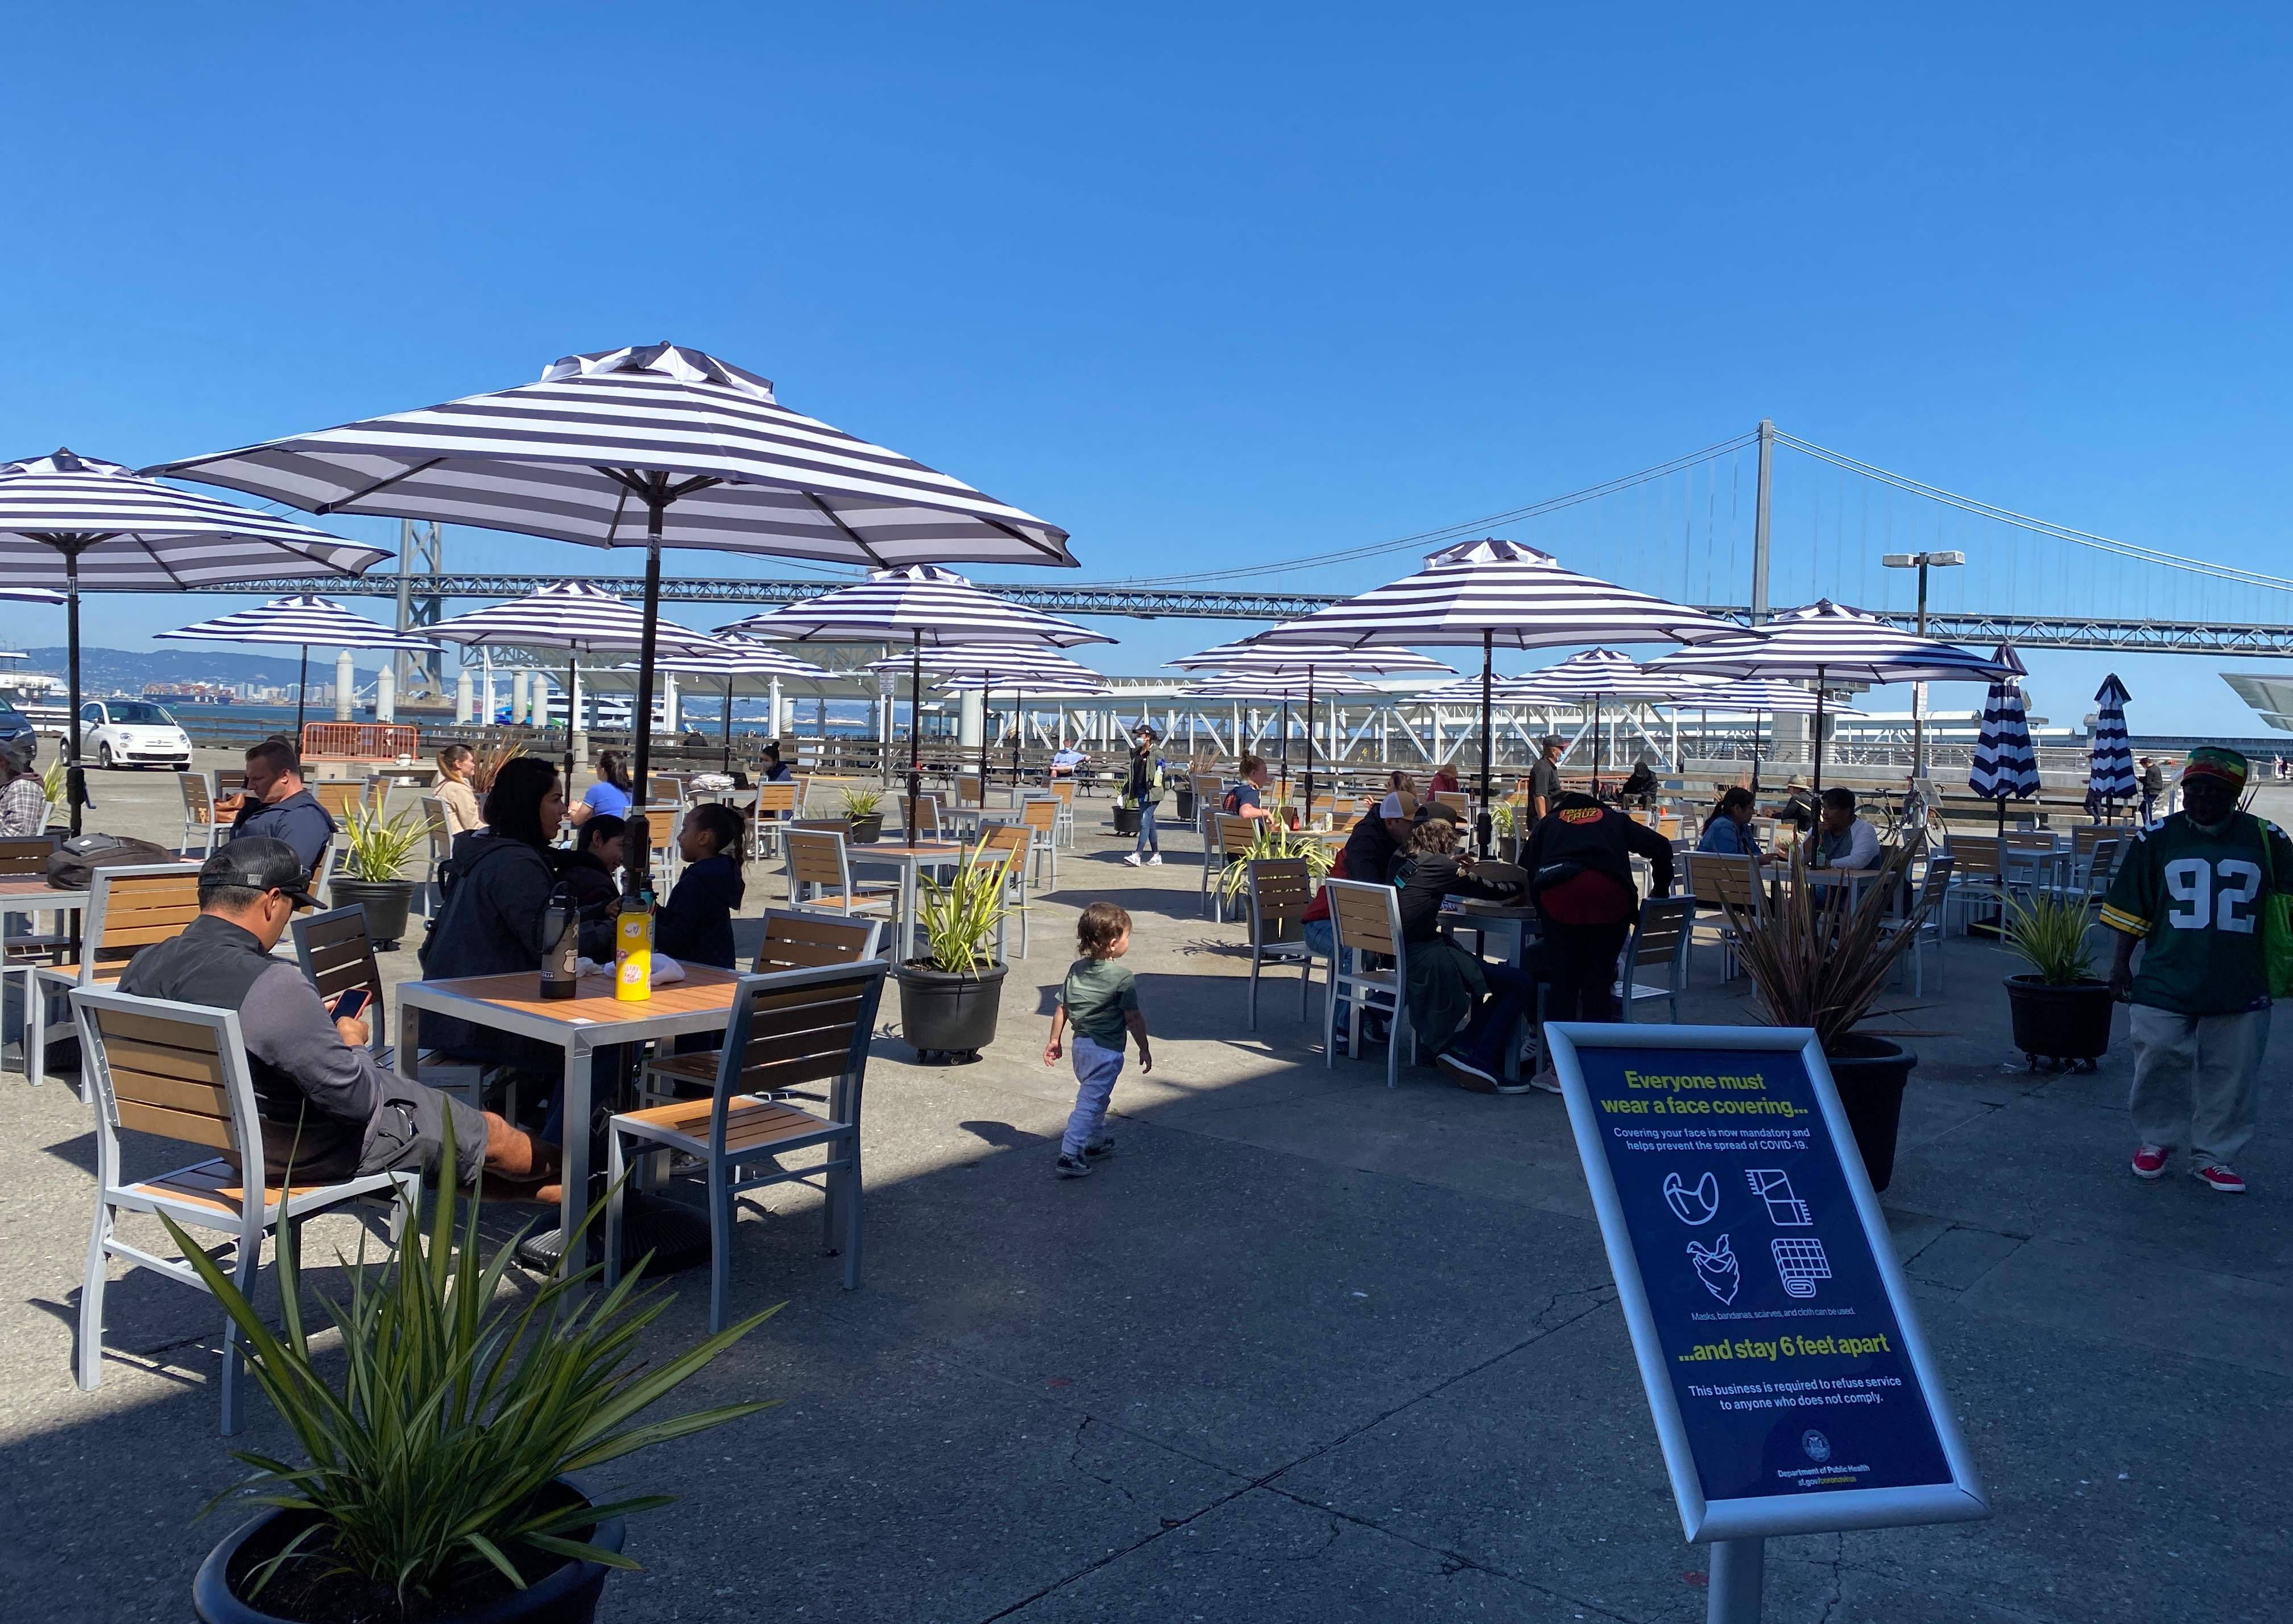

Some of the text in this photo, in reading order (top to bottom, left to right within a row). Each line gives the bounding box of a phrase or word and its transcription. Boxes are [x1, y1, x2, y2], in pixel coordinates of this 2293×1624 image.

[1567, 809, 1597, 823] CRUZ
[2164, 858, 2261, 934] 92
[1624, 1071, 1766, 1092] Everyone must
[1600, 1096, 1808, 1118] wear a face covering...
[1613, 1128, 1659, 1138] Covering
[1659, 1129, 1682, 1138] your
[1684, 1128, 1706, 1137] face
[1707, 1128, 1717, 1137] is
[1739, 1128, 1790, 1138] mandatory
[1791, 1128, 1810, 1137] and
[1626, 1140, 1808, 1151] helps prevent the spread of COVID-19.
[1691, 1312, 1717, 1321] Masks,
[1716, 1311, 1754, 1320] bandanas,
[1783, 1308, 1798, 1317] and
[1797, 1308, 1815, 1316] cloth
[1837, 1307, 1856, 1315] used.
[1678, 1333, 1891, 1361] ...and stay 6 feet apart
[1688, 1376, 1902, 1397] This business is required to refuse service
[1719, 1391, 1884, 1411] to anyone who does not comply.
[1777, 1468, 1820, 1478] Department
[1827, 1465, 1849, 1474] Public
